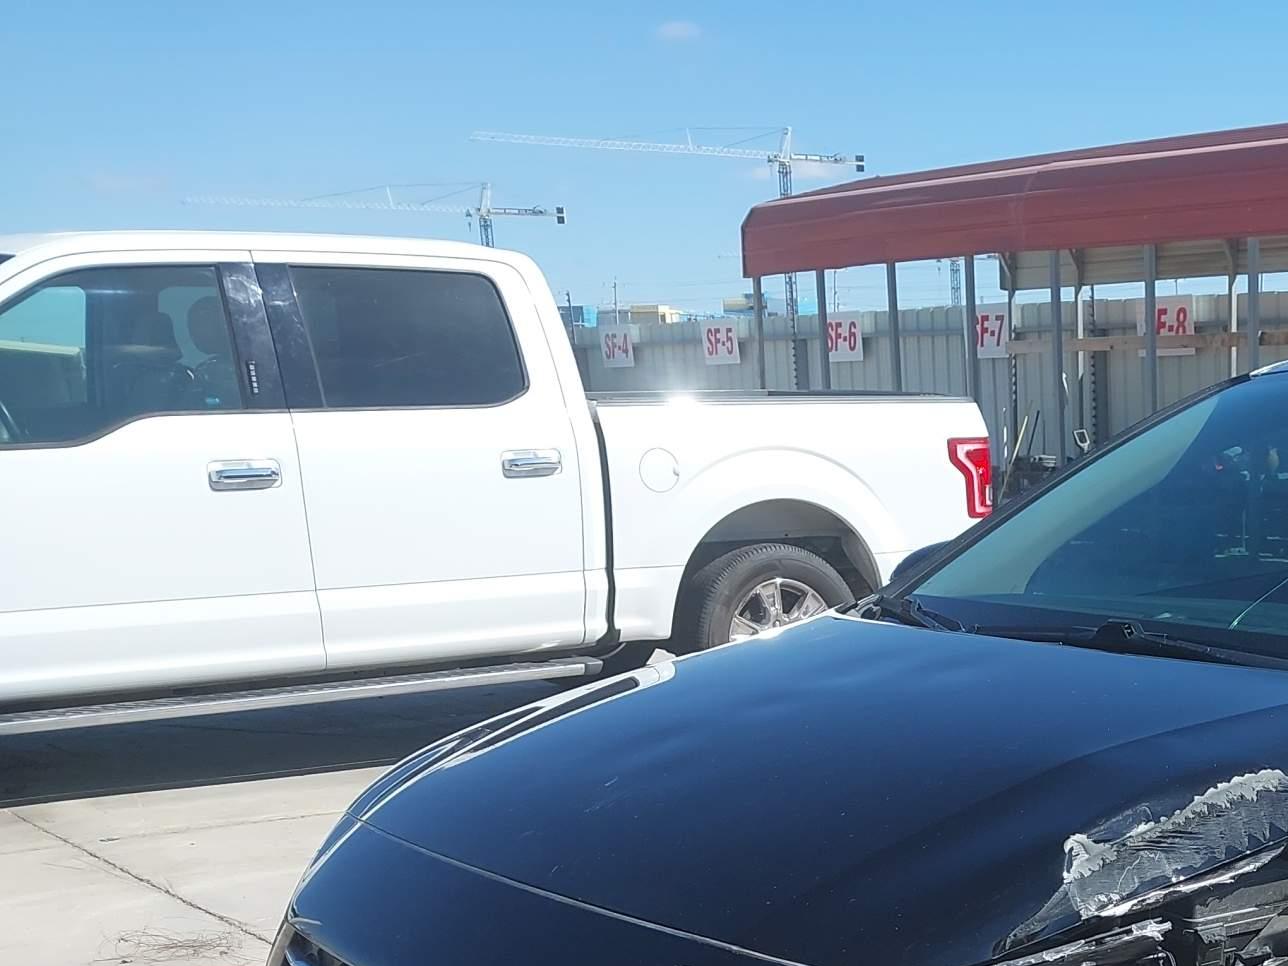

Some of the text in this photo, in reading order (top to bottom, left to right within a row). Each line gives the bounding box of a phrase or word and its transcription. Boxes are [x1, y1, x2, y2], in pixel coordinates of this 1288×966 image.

[1156, 306, 1188, 335] F-8
[604, 333, 629, 360] SF-4
[706, 327, 734, 357] SF-5
[827, 320, 857, 352] SF-6
